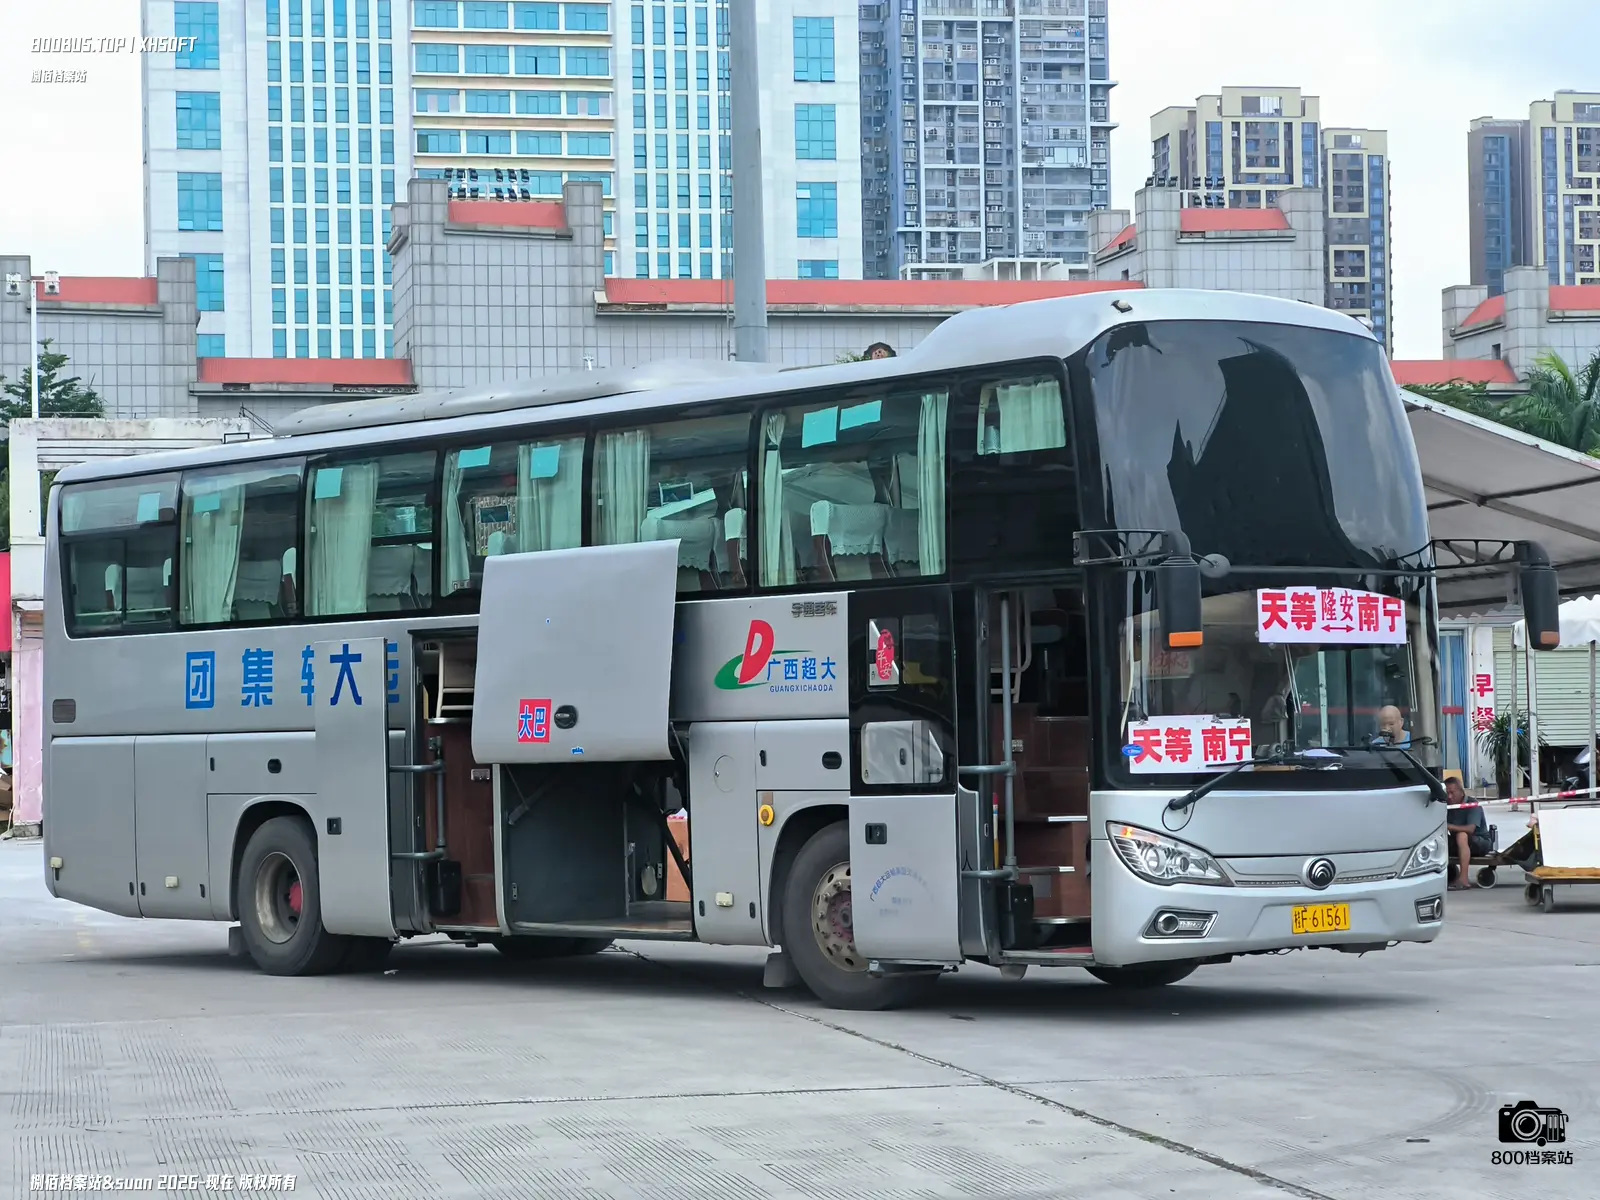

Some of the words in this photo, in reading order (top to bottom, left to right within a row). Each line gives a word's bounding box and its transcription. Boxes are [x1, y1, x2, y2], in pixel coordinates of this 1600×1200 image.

[767, 656, 836, 681] 广西超大
[769, 684, 834, 692] GUANGXICHAODA
[518, 704, 547, 739] 大巴
[1132, 727, 1192, 764] 天等
[1201, 726, 1251, 761] 南宁
